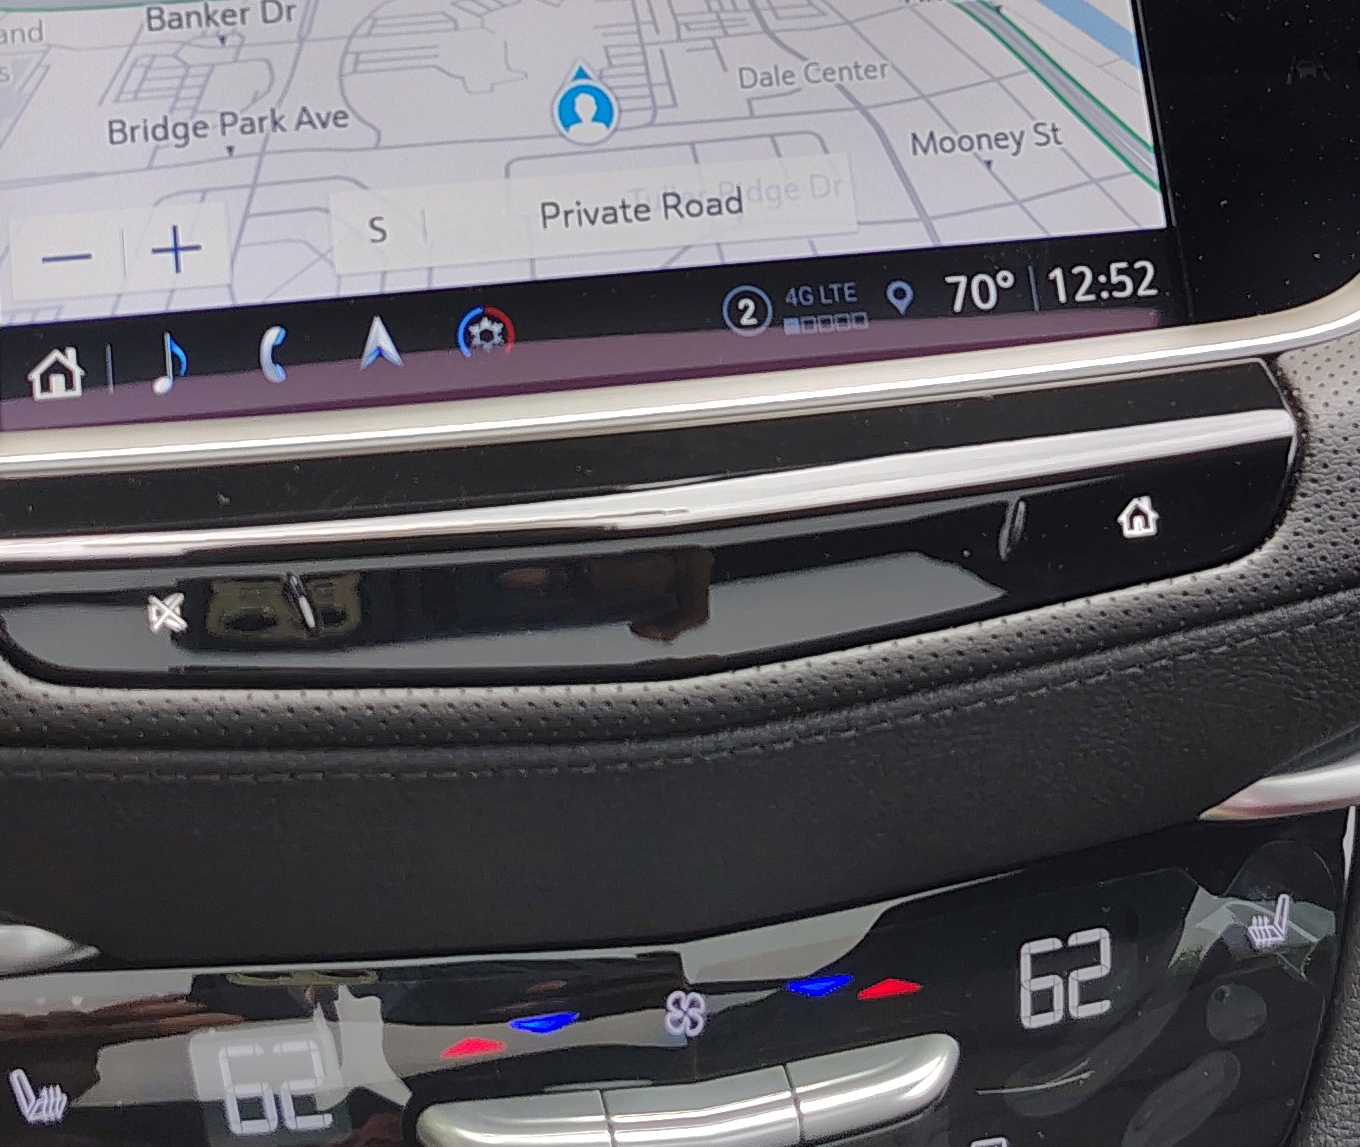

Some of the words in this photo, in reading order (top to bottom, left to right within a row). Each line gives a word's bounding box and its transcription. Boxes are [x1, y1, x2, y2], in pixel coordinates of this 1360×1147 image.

[146, 3, 250, 32] Banker
[261, 0, 297, 25] Dr
[738, 65, 797, 90] Dale
[803, 59, 890, 84] Center
[107, 115, 209, 150] Bridge
[220, 110, 288, 138] Park
[294, 106, 350, 131] Ave
[911, 128, 1025, 159] Mooney
[1033, 123, 1063, 147] St
[809, 173, 843, 200] Dr
[541, 198, 651, 231] Private
[661, 185, 744, 221] Road
[369, 217, 388, 245] S
[785, 287, 813, 308] 4G
[819, 283, 858, 305] LTE
[1048, 260, 1159, 305] 12:52
[737, 298, 758, 326] 2
[1020, 926, 1113, 1030] 62
[218, 1039, 335, 1135] 62
